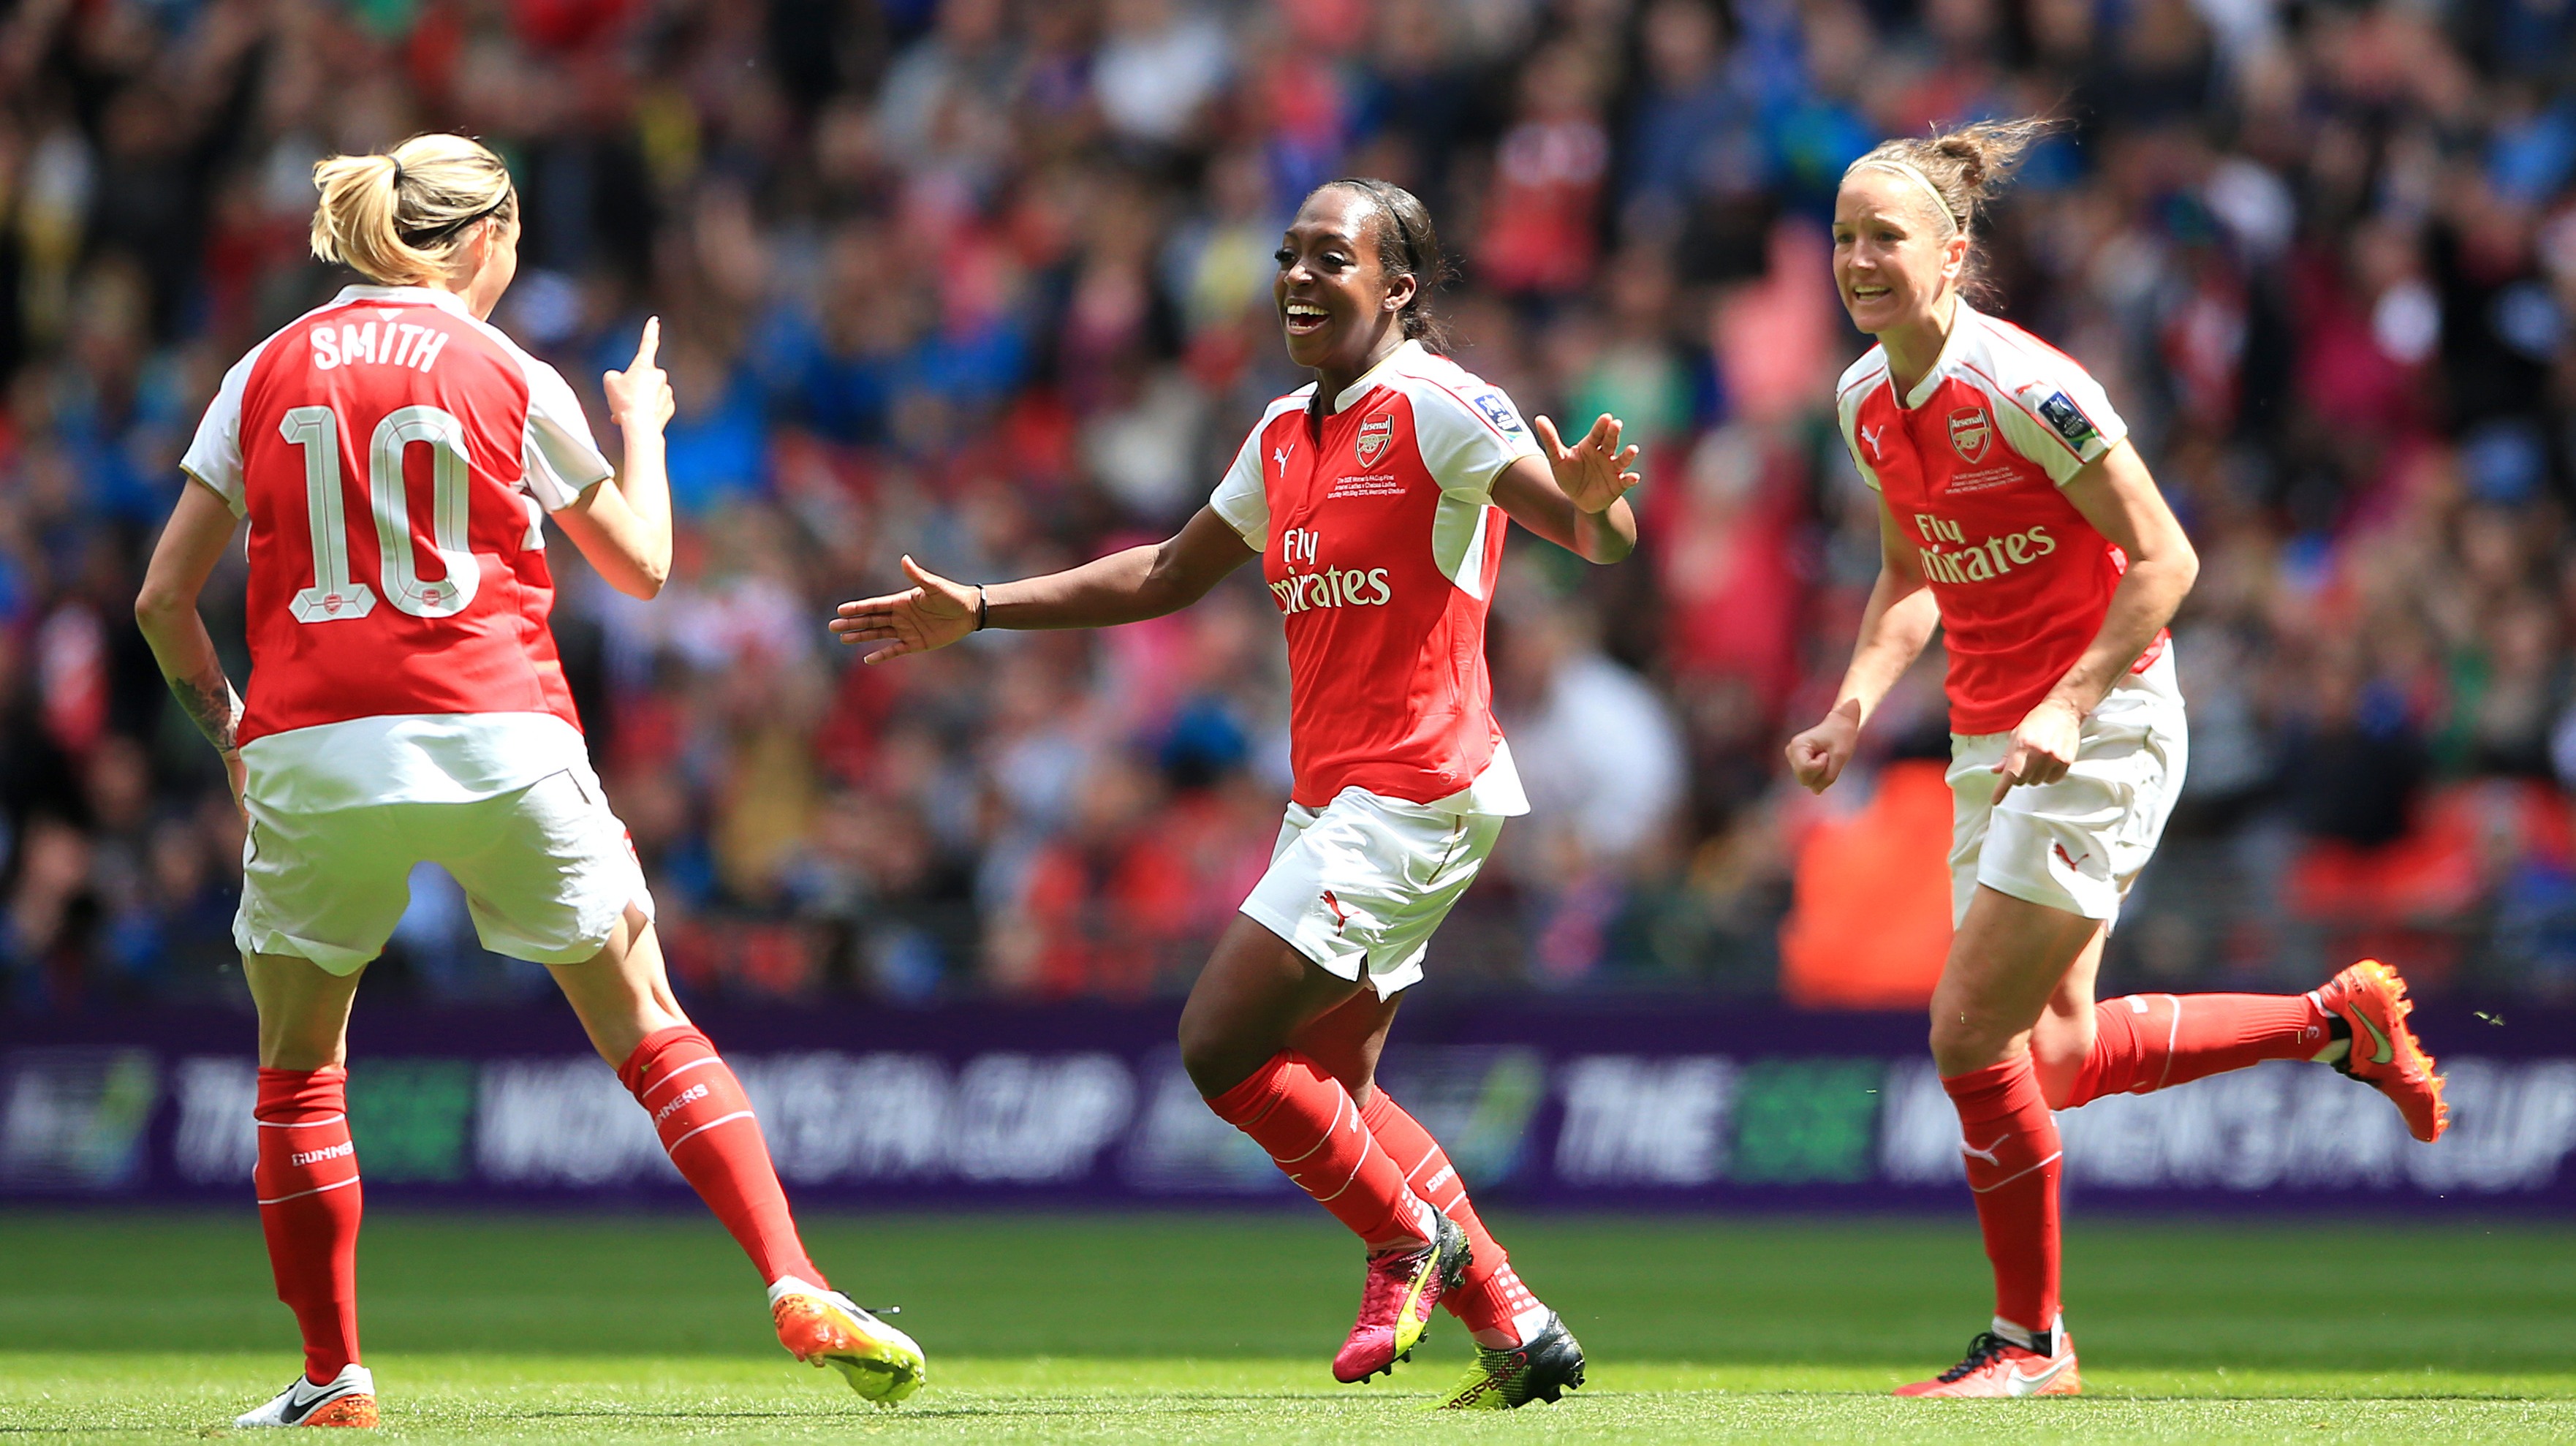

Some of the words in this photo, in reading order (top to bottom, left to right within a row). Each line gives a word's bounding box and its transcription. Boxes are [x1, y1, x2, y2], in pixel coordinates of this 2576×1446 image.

[310, 321, 450, 374] SMITH
[1361, 420, 1388, 431] Arsenal
[1952, 414, 1983, 429] Arsenal
[278, 404, 480, 624] 10
[1914, 514, 1966, 545] Fly
[1284, 527, 1319, 565] Fly
[1919, 526, 2056, 584] mirates
[1268, 564, 1391, 616] mirates
